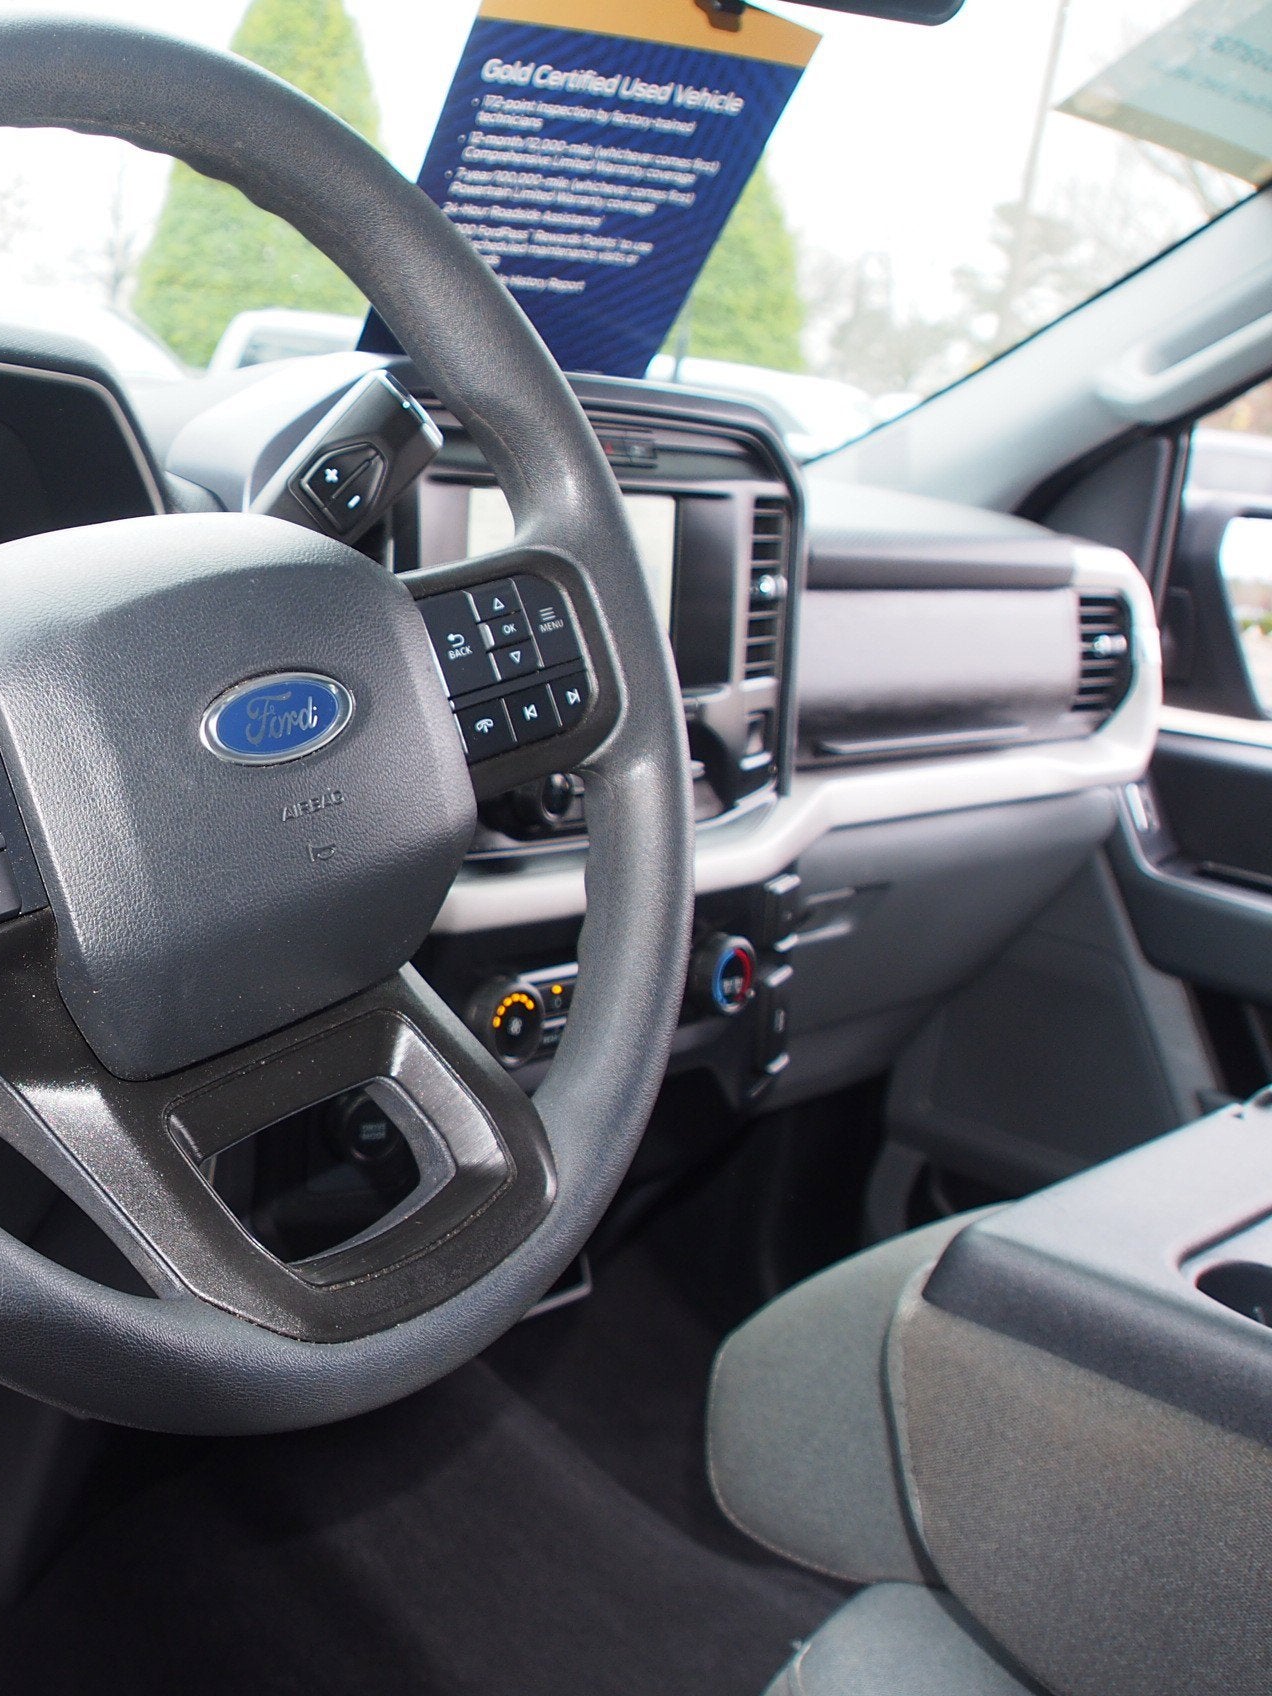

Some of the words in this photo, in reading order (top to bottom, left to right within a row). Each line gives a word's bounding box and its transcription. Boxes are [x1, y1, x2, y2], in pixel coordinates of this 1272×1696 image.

[481, 58, 535, 87] Gold
[532, 64, 622, 98] Certified
[618, 74, 675, 105] Used
[672, 84, 745, 116] Vehicle
[475, 110, 544, 132] technicians
[536, 101, 596, 121] inspection
[594, 107, 611, 126] by
[610, 109, 697, 137] factory-trained
[461, 146, 552, 170] Comprehensive
[551, 154, 596, 174] Limited
[595, 160, 645, 182] Warranty
[644, 167, 697, 188] coverage
[594, 145, 654, 167] (whichever
[653, 154, 693, 172] comes
[692, 157, 721, 178] first)
[448, 181, 513, 204] Powertrain
[512, 185, 556, 207] Limited
[555, 191, 606, 213] Warranty
[606, 199, 657, 217] coverage
[569, 177, 630, 199] (whichever
[629, 186, 668, 204] comes
[488, 205, 542, 224] Roadside
[527, 244, 598, 266] maintenance
[620, 239, 633, 254] to
[547, 277, 586, 296] Report
[503, 624, 517, 635] OK
[539, 619, 564, 633] MENU
[448, 646, 473, 660] BACK
[246, 691, 318, 746] Ford
[282, 788, 345, 822] AIRBAG
